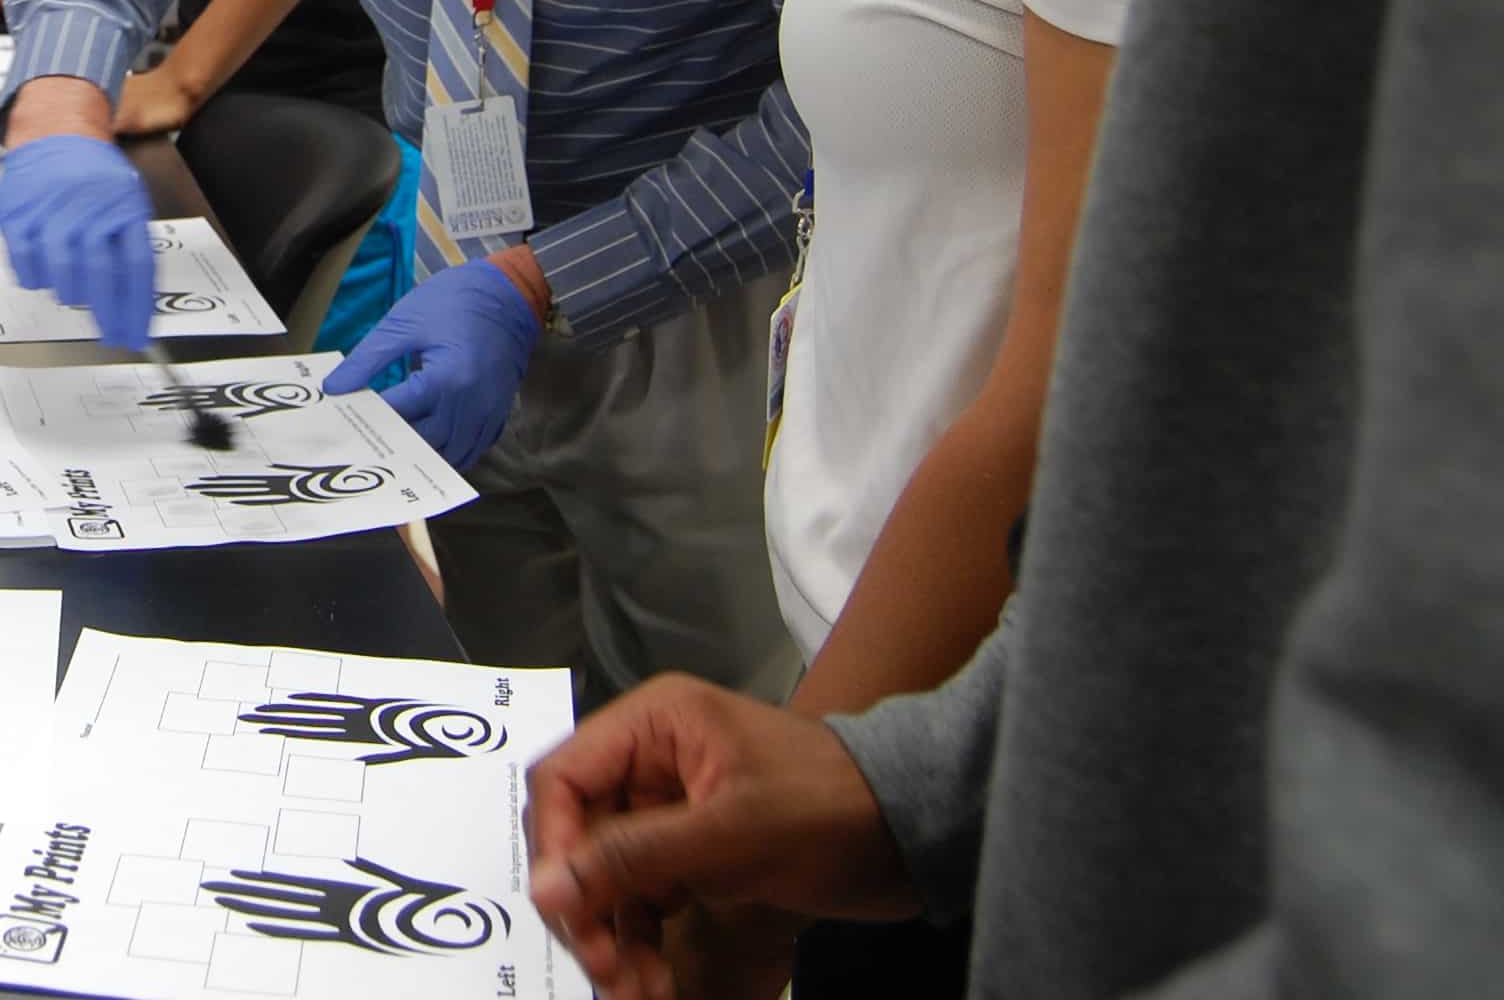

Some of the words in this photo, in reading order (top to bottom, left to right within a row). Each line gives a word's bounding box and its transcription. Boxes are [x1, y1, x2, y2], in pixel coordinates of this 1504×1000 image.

[62, 469, 102, 500] Prints
[70, 501, 112, 517] My
[495, 677, 512, 707] Right
[23, 822, 91, 884] Prints
[9, 884, 80, 919] My
[497, 964, 516, 999] Left
